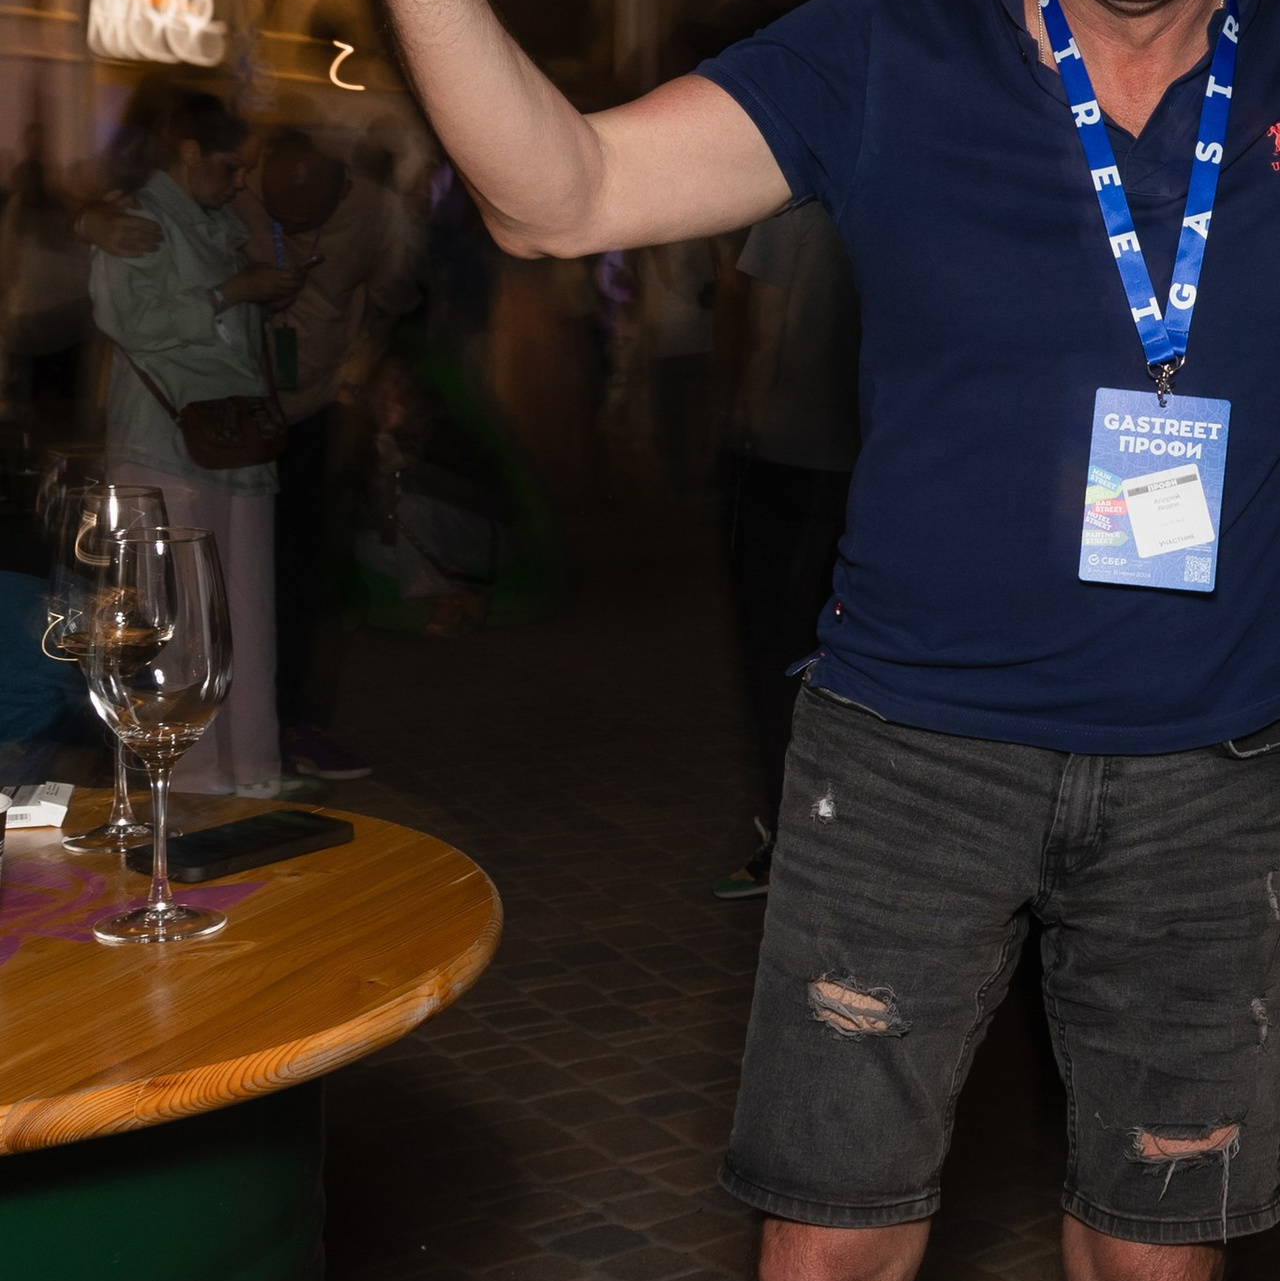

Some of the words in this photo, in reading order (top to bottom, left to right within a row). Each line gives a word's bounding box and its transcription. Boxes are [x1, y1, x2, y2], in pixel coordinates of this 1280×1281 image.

[1103, 413, 1223, 441] GASTREET
[1119, 435, 1203, 460] ПРОФИ
[1085, 517, 1113, 532] STREET
[1087, 510, 1111, 524] HOTEL
[1101, 556, 1127, 566] СБЕР
